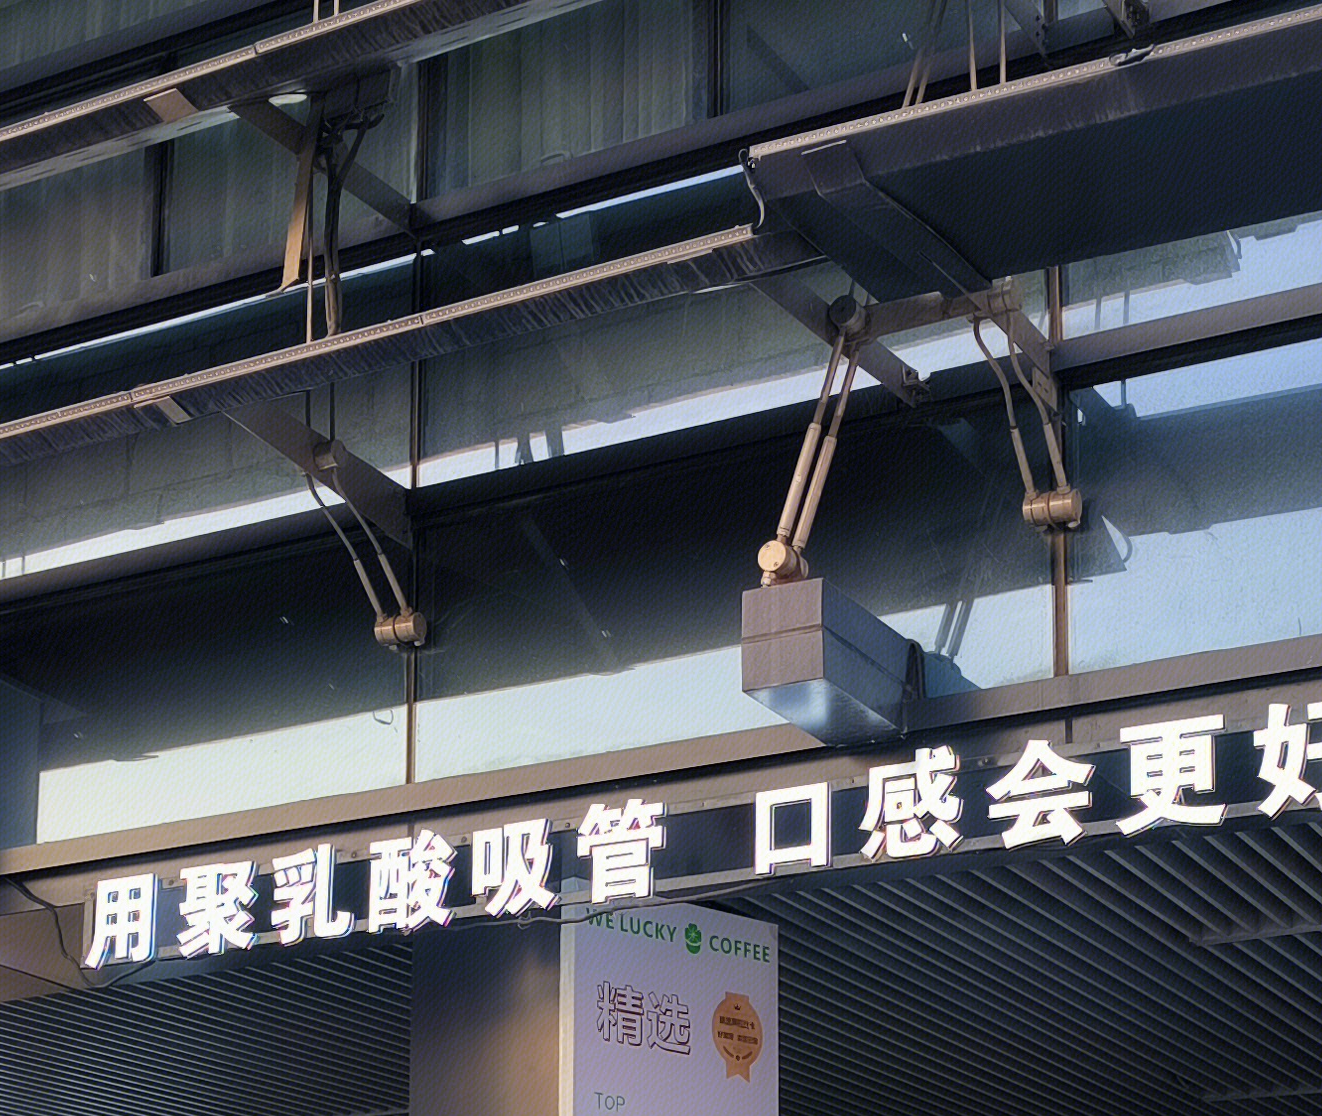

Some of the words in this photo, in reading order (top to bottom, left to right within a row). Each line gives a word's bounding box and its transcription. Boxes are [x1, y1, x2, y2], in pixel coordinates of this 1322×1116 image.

[85, 799, 666, 971] 用聚乳酸吸管
[620, 914, 677, 943] LUCKY
[709, 935, 771, 963] COFFEE
[596, 980, 691, 1056] 精选
[594, 1092, 626, 1112] TOP
